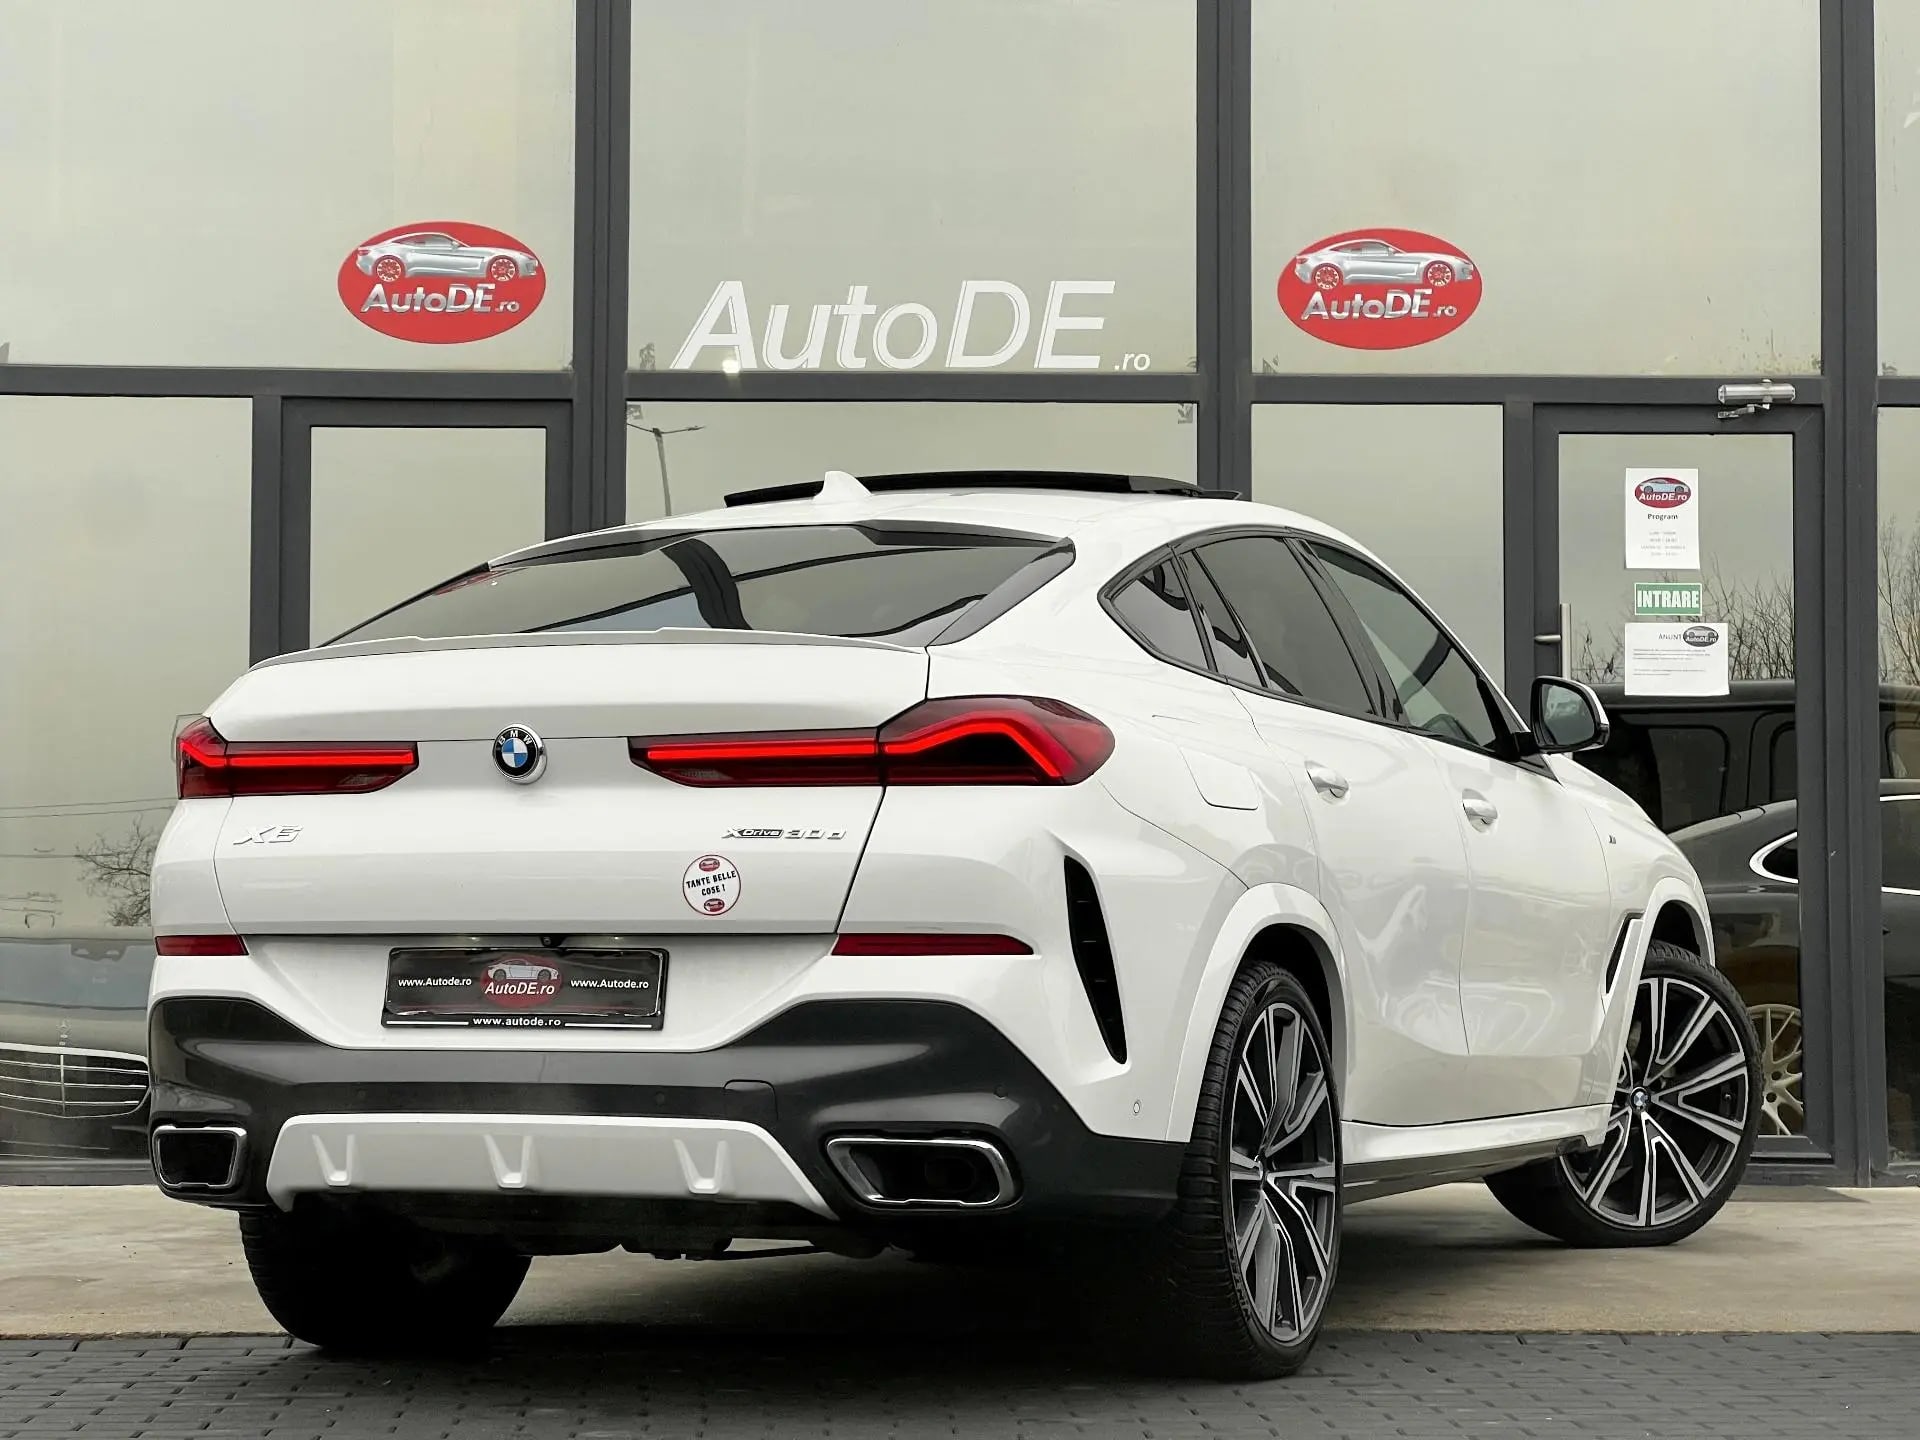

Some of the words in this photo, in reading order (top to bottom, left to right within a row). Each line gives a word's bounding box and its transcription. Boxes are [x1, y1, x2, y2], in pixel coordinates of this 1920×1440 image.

[1639, 493, 1687, 501] AutoDE.ro
[1647, 513, 1678, 521] Program
[1637, 590, 1699, 608] INTRARE
[499, 729, 532, 746] BMW
[232, 824, 304, 845] X6
[686, 876, 711, 888] TANTE
[712, 870, 737, 883] BELLE
[701, 885, 721, 896] COSE
[398, 976, 472, 987] www.Autode.ro
[570, 978, 649, 989] www.Autode.ro
[484, 982, 555, 996] AutoDE.ro
[473, 1016, 561, 1027] www.autode.ro
